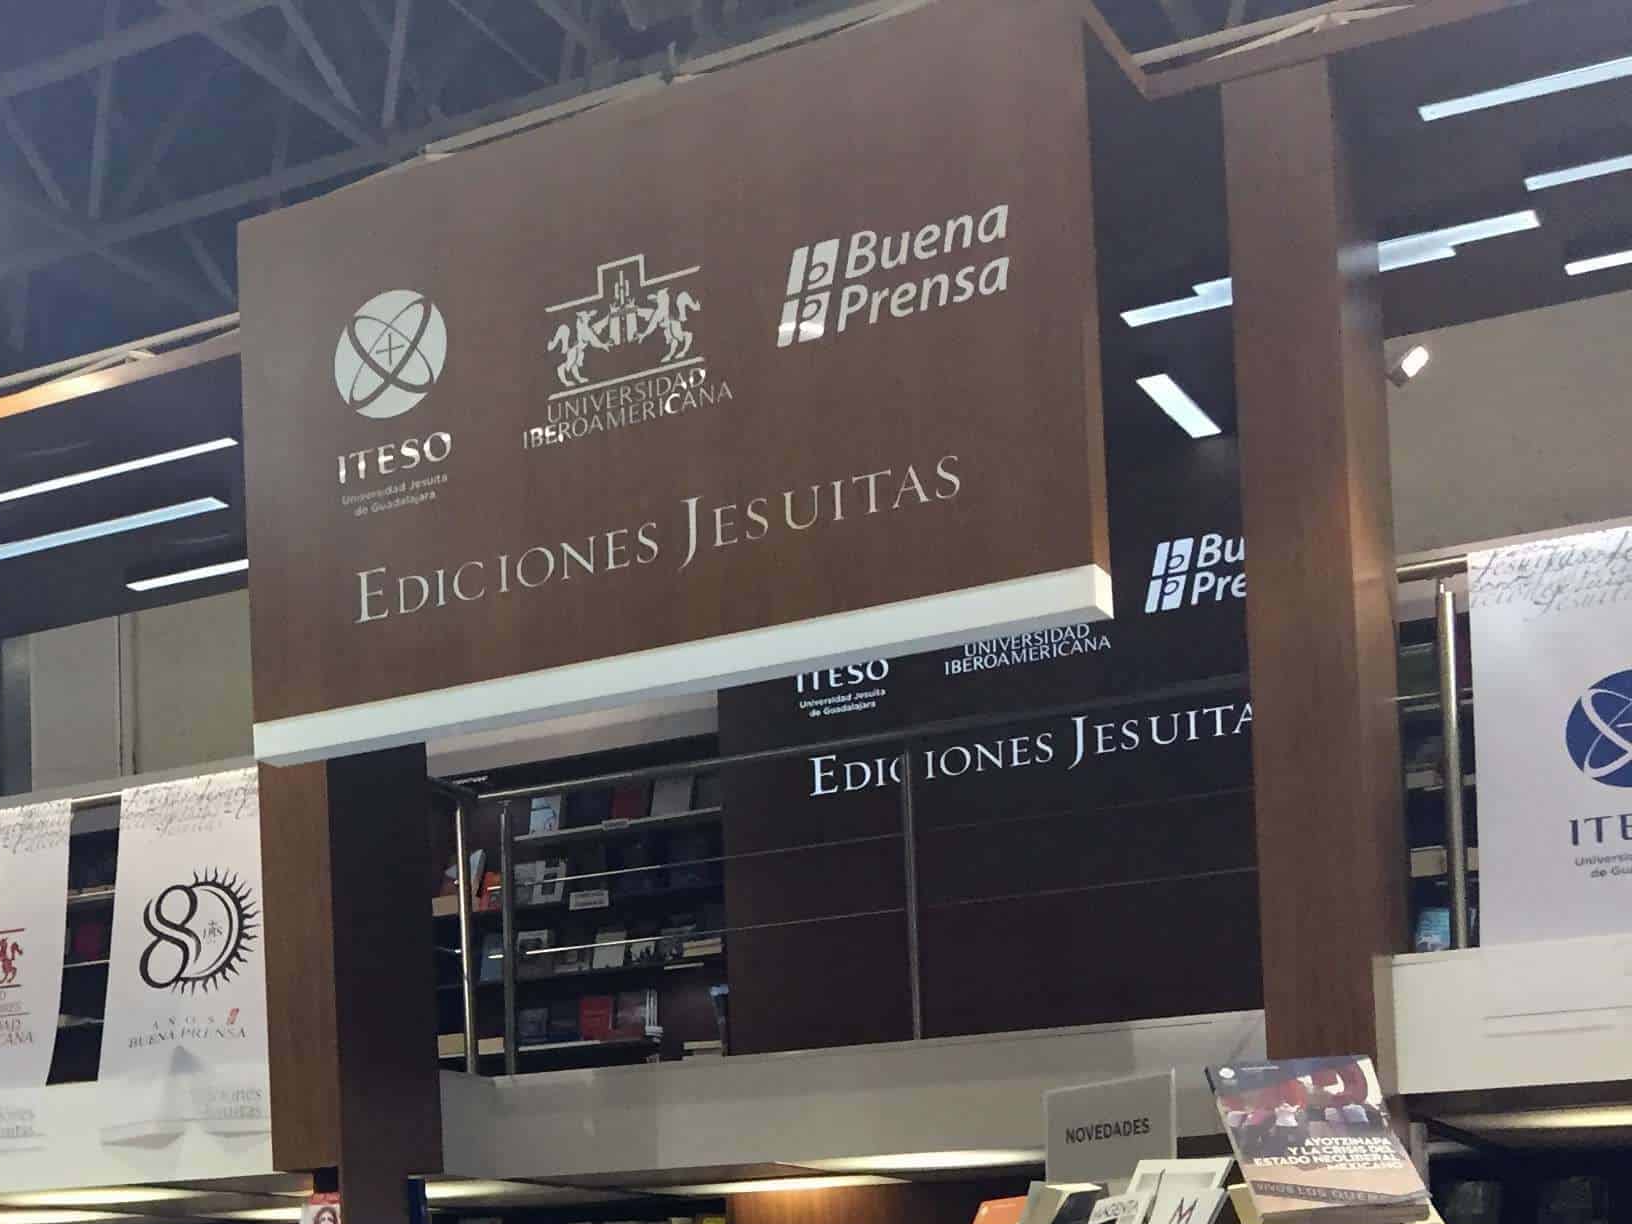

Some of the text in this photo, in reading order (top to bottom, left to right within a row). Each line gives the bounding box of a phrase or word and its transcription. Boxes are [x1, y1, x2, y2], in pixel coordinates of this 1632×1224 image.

[845, 204, 1009, 280] Buena
[837, 256, 1010, 333] Prensa
[548, 367, 706, 424] UNIVERSIDAD
[523, 381, 733, 449] IBEROAMERICANA
[337, 431, 451, 484] ITESO
[1197, 533, 1246, 568] Bu
[944, 635, 1111, 676] IBEROAMERICANA
[964, 623, 1090, 658] UNIVERSIDAD
[800, 688, 887, 709] Universidad Jesuita
[808, 701, 876, 718] de Guadalajara
[1065, 1117, 1151, 1146] NOVEDADES
[1253, 1155, 1311, 1167] ESTADO
[1288, 1147, 1298, 1156] Y
[1302, 1146, 1321, 1155] LA
